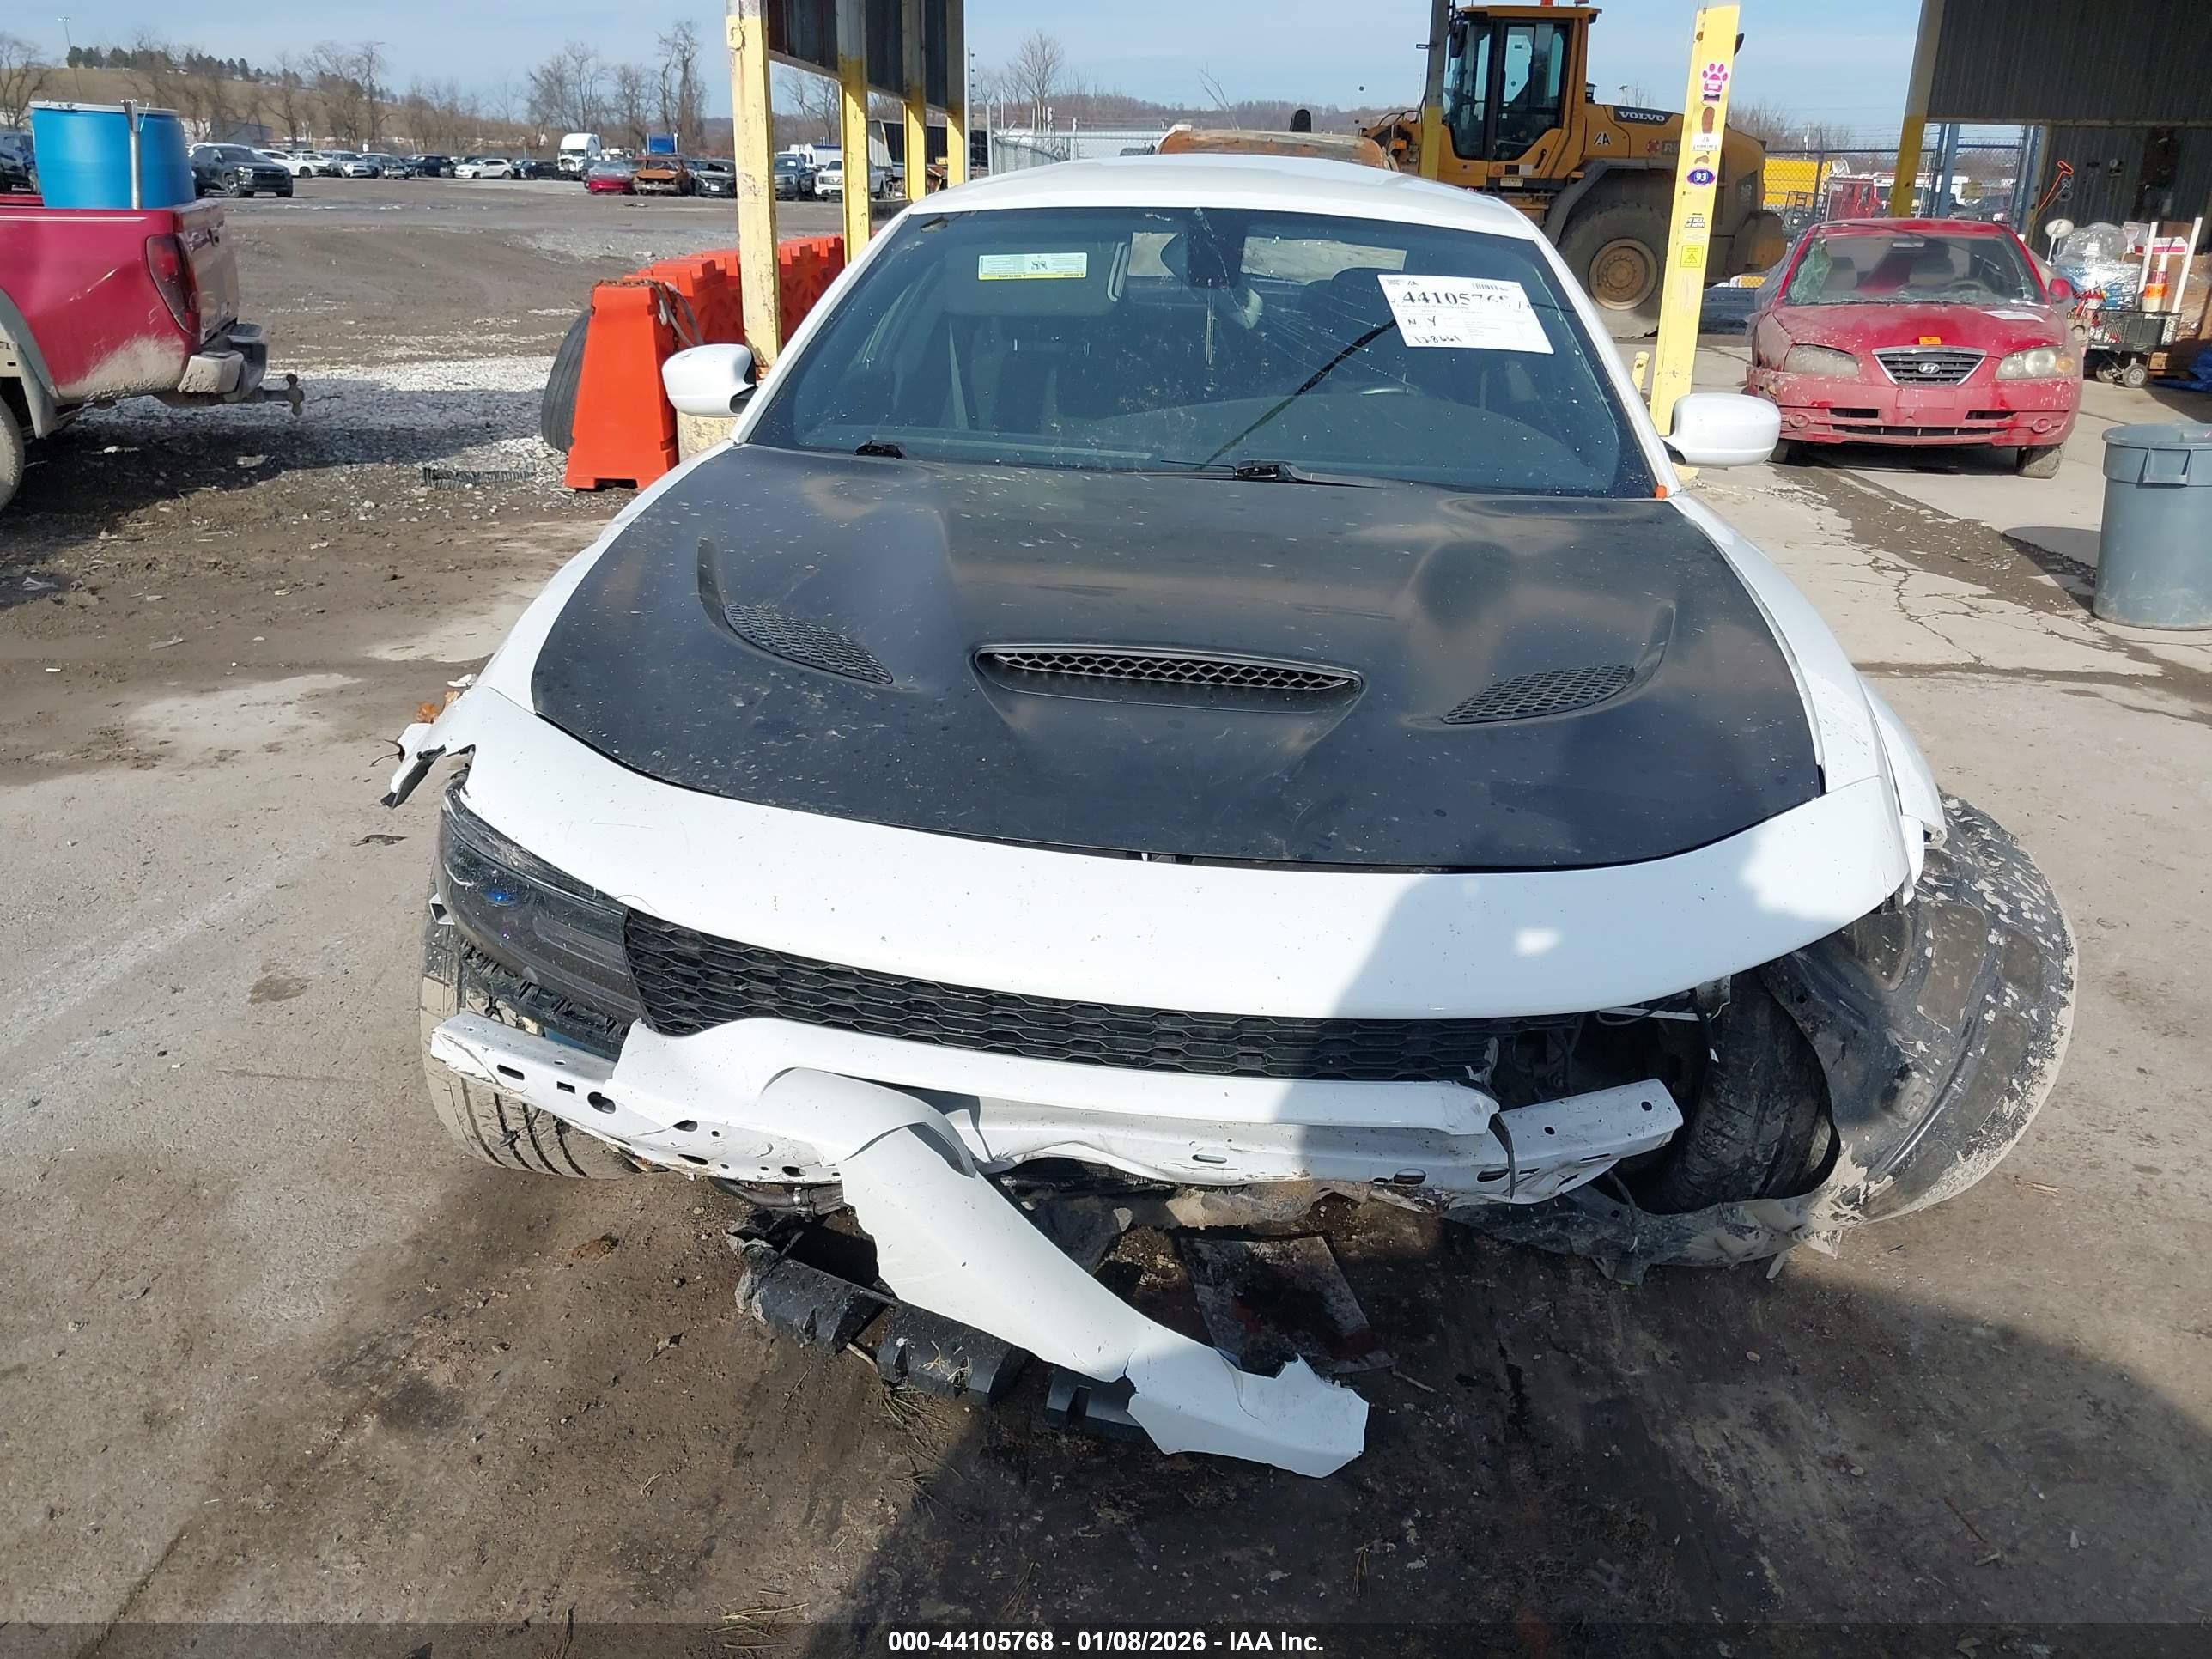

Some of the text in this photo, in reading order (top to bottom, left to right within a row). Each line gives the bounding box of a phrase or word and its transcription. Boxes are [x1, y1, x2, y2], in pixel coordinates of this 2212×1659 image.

[1618, 110, 1666, 122] VOLVO
[1695, 172, 1707, 182] 93
[1427, 315, 1437, 326] Y
